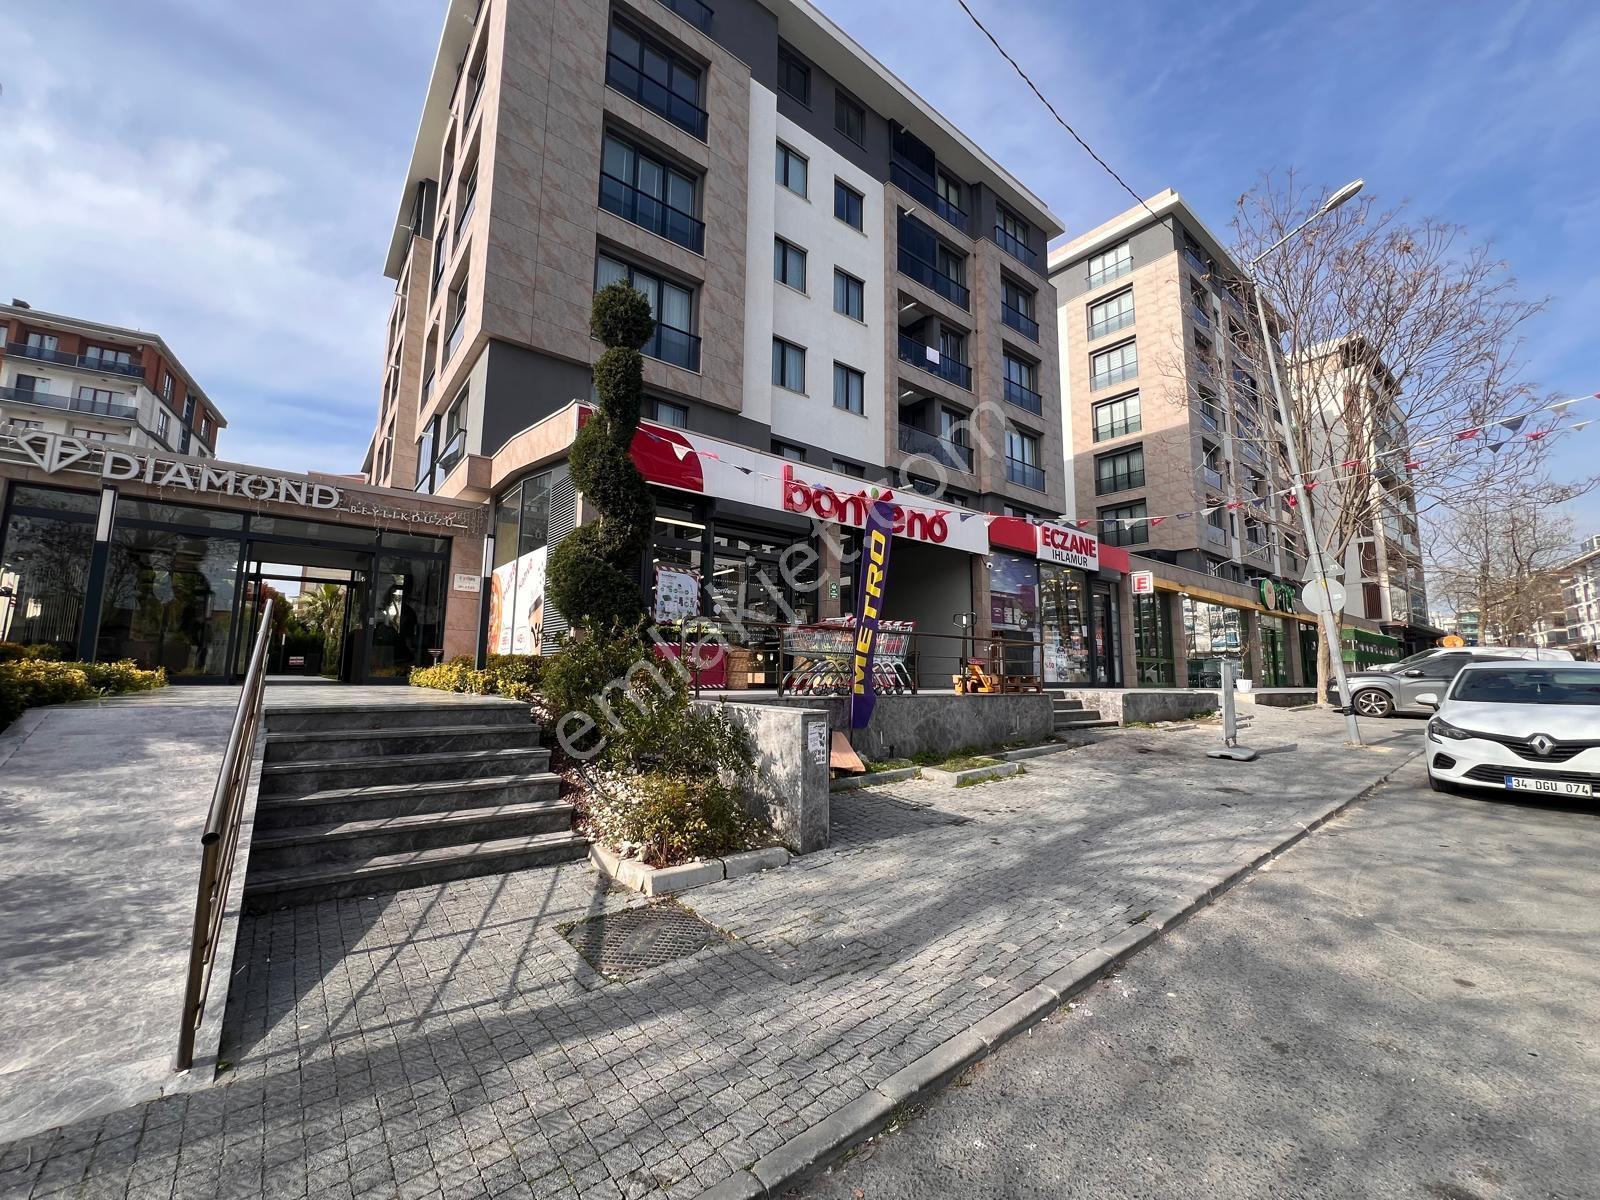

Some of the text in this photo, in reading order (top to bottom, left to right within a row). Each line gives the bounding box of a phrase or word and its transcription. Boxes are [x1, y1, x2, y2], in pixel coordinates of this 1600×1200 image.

[102, 451, 340, 509] DIAMOND
[1042, 526, 1096, 558] ECZANE
[1052, 549, 1088, 567] IHLAMUR
[1136, 577, 1148, 590] E
[853, 529, 886, 695] METRO
[1514, 779, 1589, 794] 34 DGU 074
